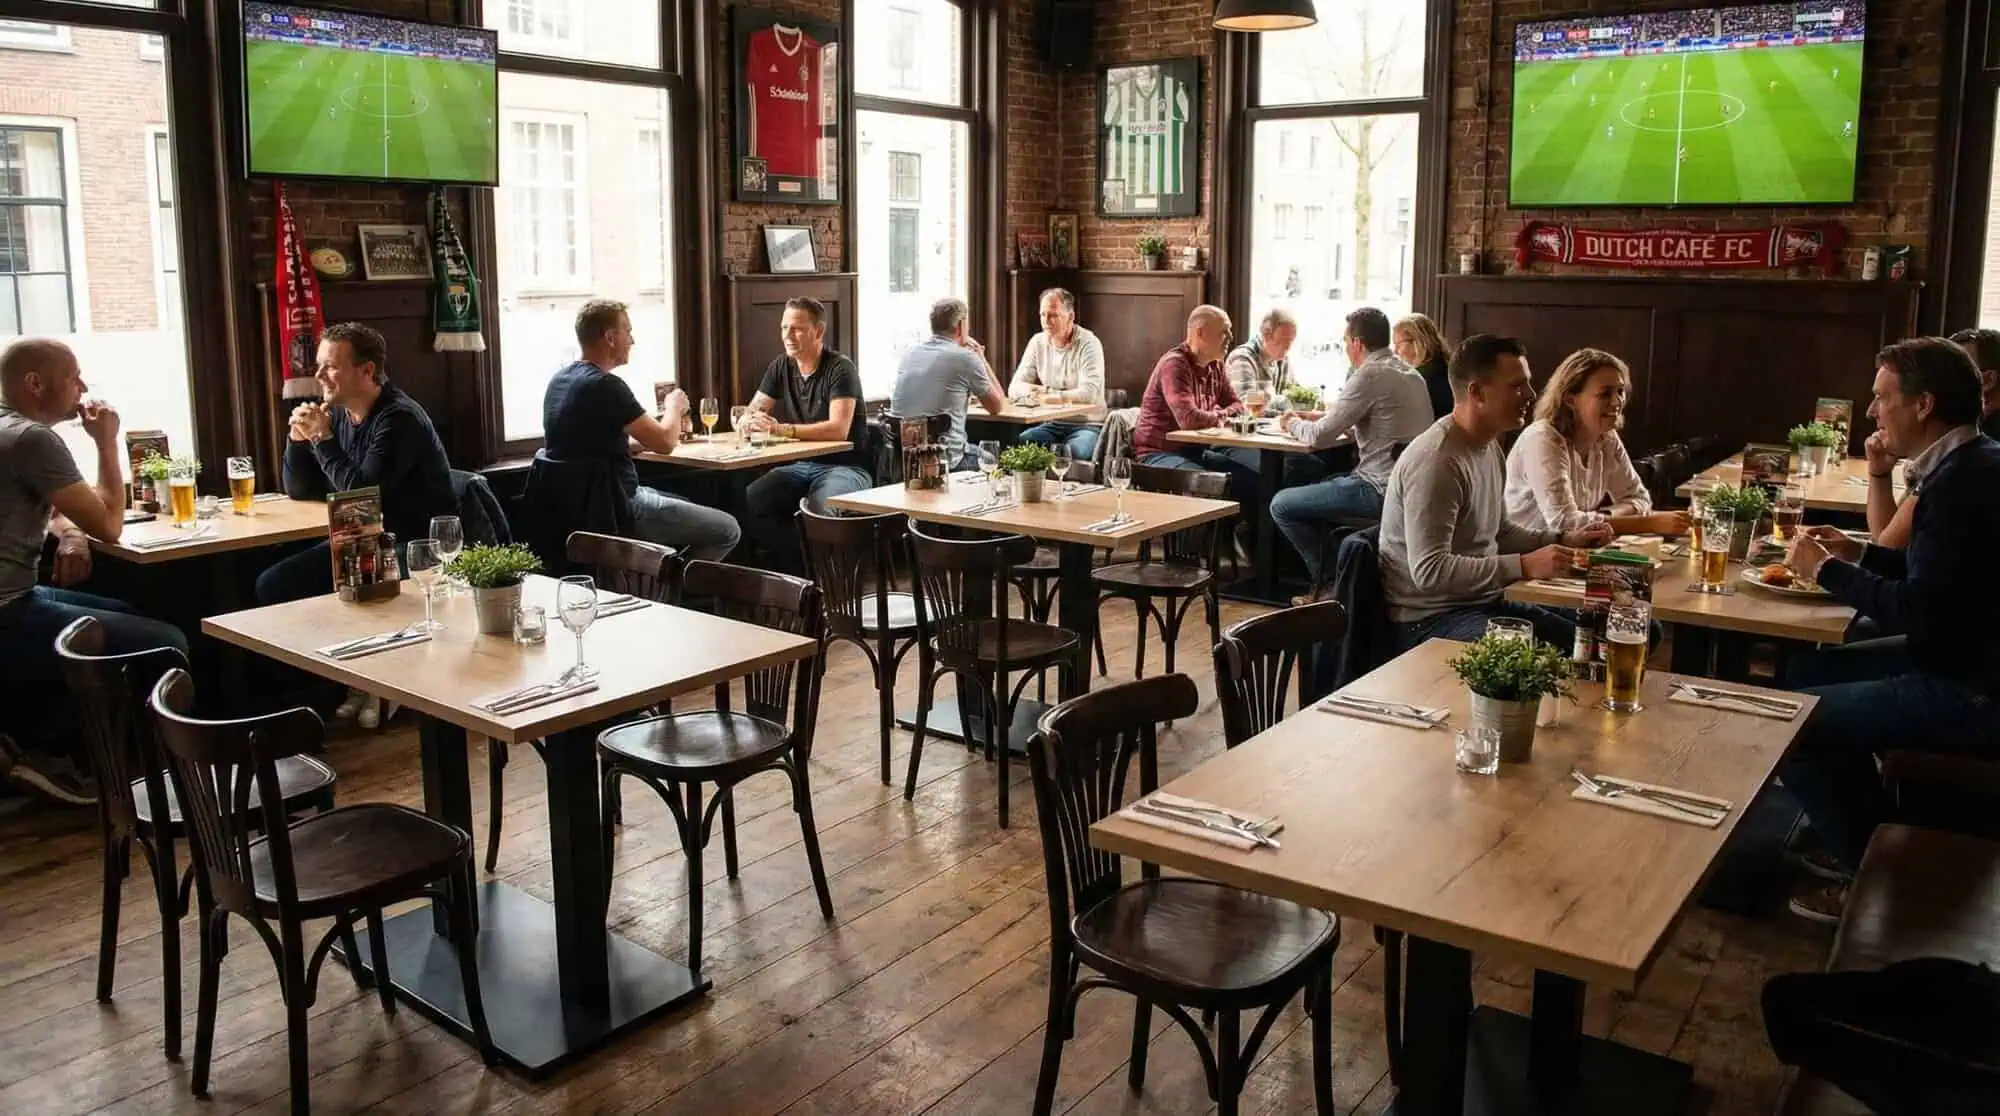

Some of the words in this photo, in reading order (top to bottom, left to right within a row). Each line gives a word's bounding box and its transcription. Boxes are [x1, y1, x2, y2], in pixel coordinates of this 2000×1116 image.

[1586, 236, 1653, 258] DUTCH
[1660, 234, 1717, 259] CAFÉ
[1725, 238, 1753, 259] FC
